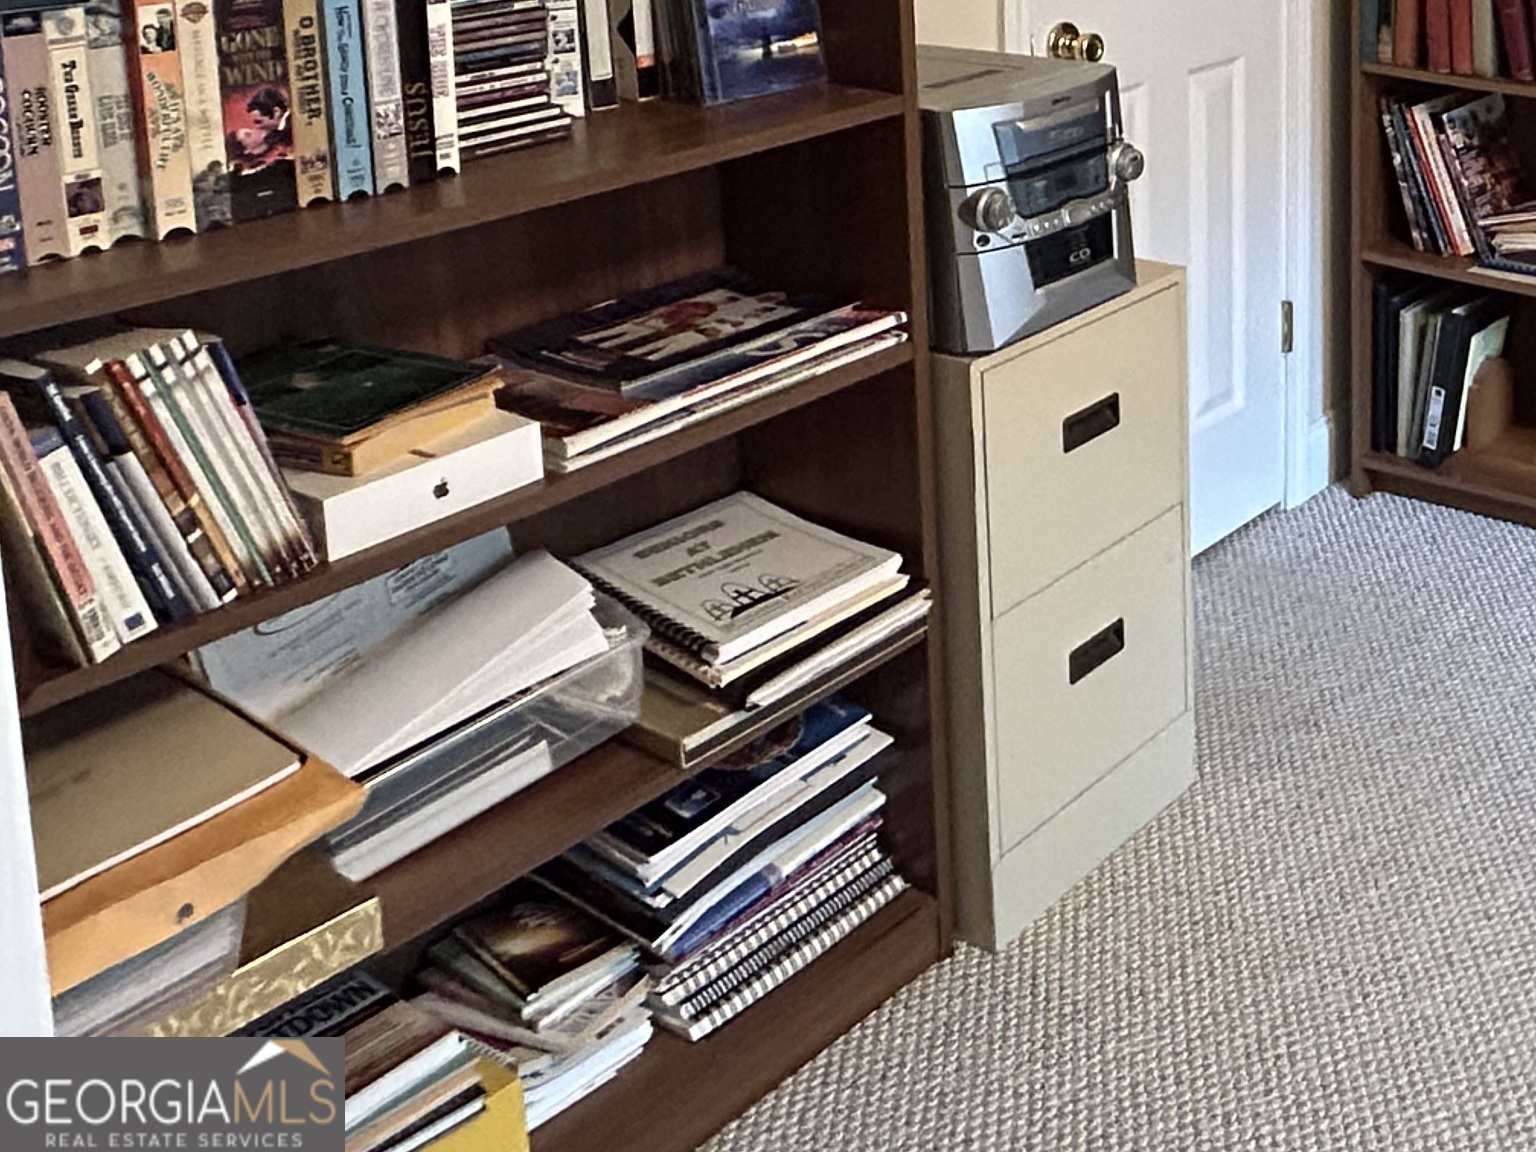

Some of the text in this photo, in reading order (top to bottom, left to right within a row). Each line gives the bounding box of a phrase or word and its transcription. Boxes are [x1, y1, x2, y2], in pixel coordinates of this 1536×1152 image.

[299, 15, 314, 30] O
[221, 26, 279, 53] GONE
[222, 60, 283, 85] WIND
[34, 85, 52, 147] ROOSTER
[1069, 247, 1091, 263] CD
